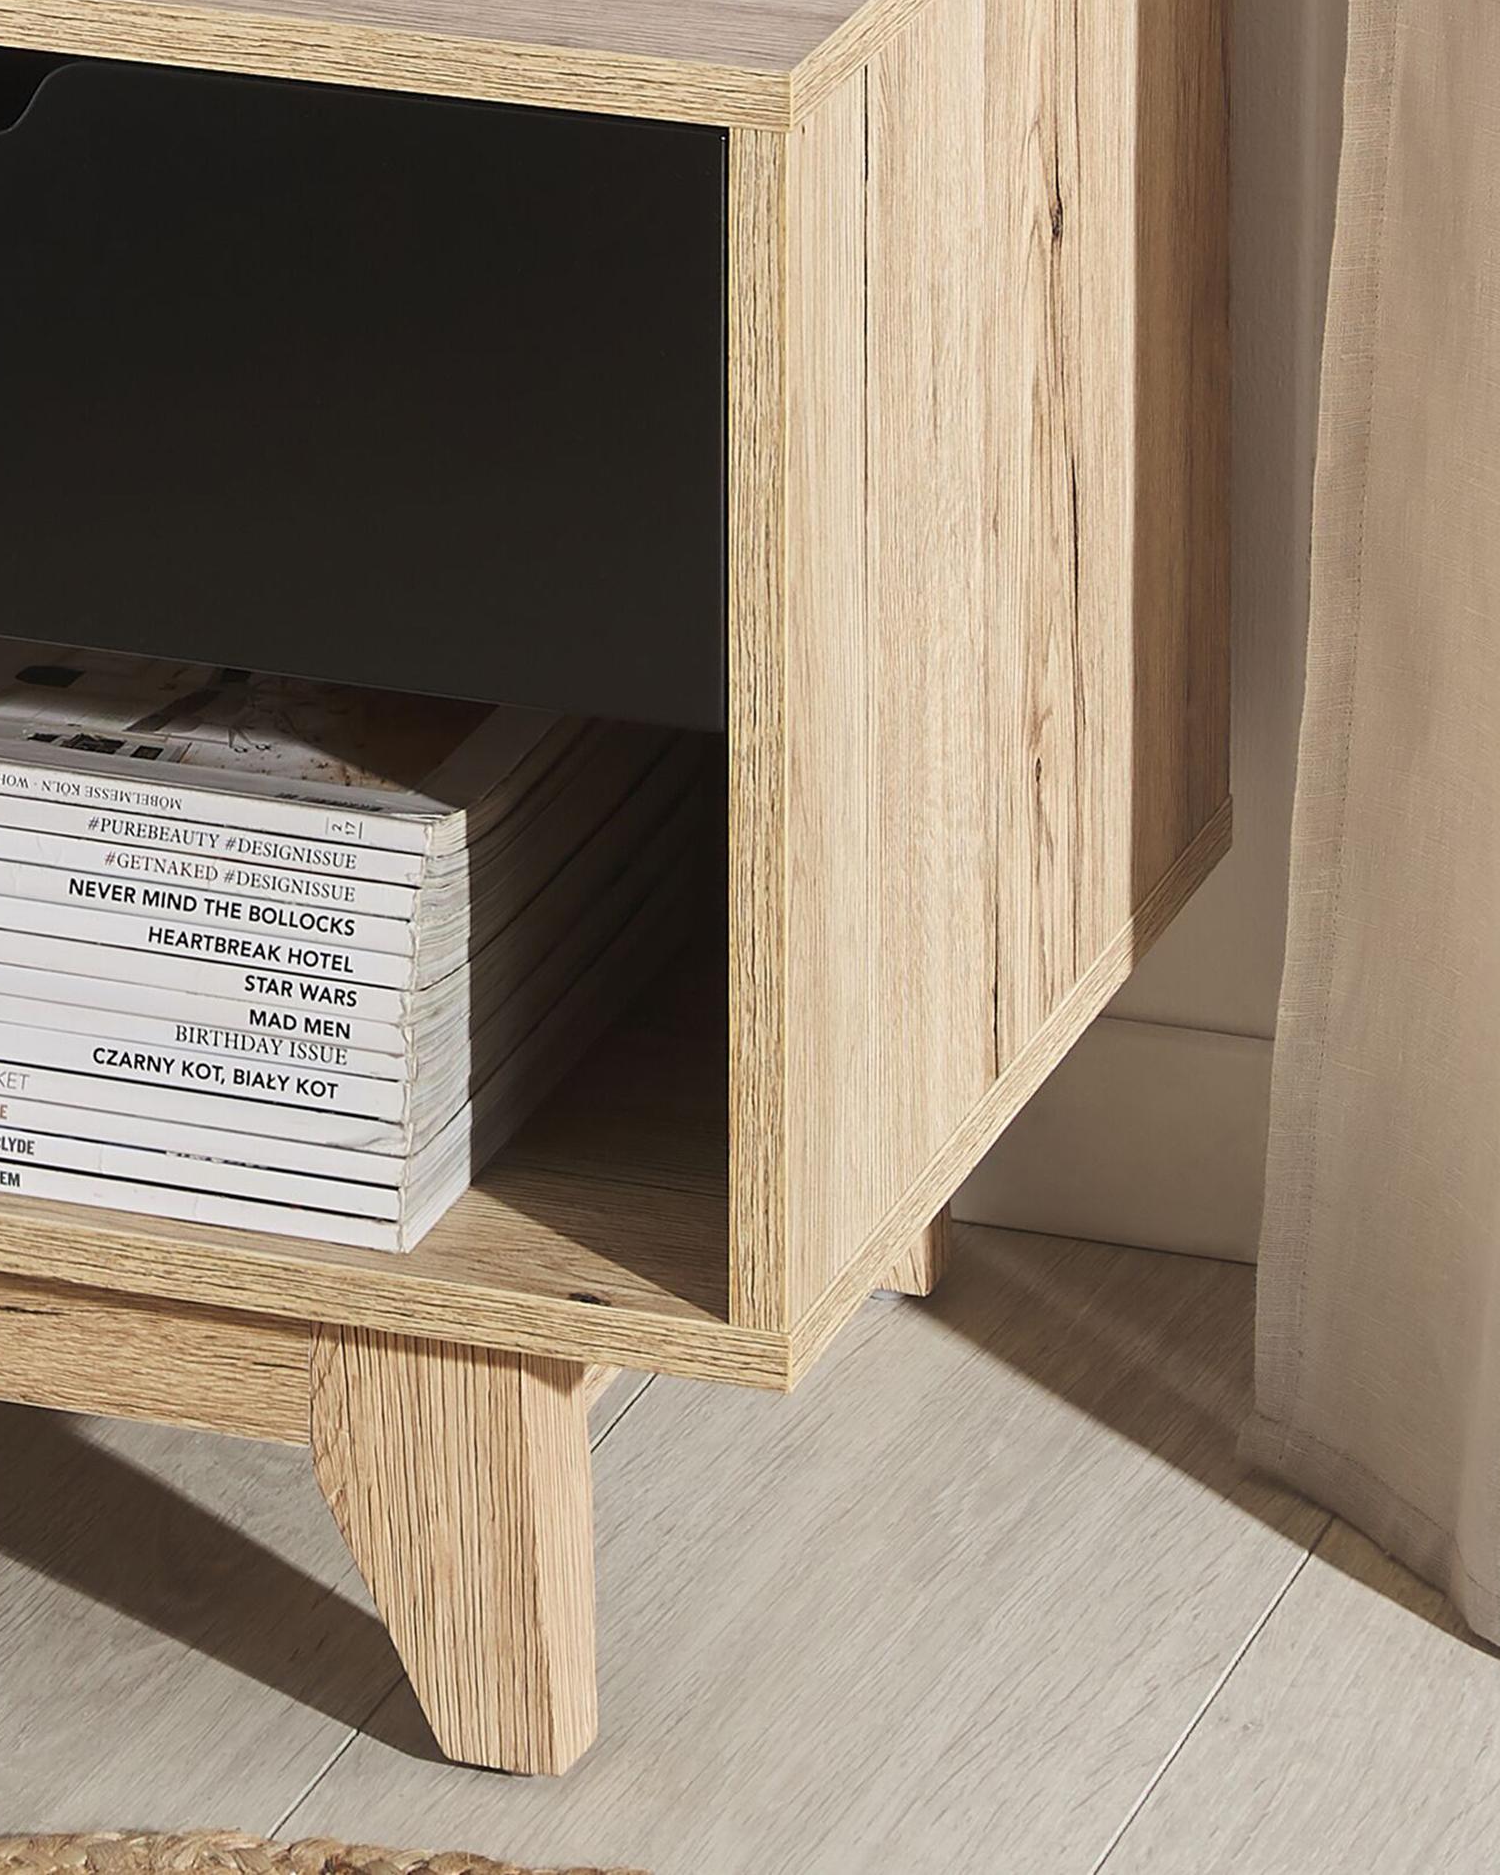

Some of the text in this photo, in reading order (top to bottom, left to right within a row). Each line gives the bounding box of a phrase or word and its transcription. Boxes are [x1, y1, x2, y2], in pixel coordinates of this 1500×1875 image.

[41, 779, 81, 796] KÖLN
[88, 815, 358, 870] #PUREBEAUTY #DESIGNISSUE
[104, 851, 356, 903] #GETNAKED #DESIGNISSUE
[68, 878, 356, 937] NEVER MIND THE BOLLOCKS
[148, 926, 354, 973] HEARTBREAK HOTEL
[245, 975, 358, 1008] STAR WARS
[174, 1025, 348, 1066] BIRTHDAY ISSUE
[249, 1009, 351, 1040] MAD MEN
[92, 1047, 339, 1100] CZARNY KOT, BIAŁY KOT
